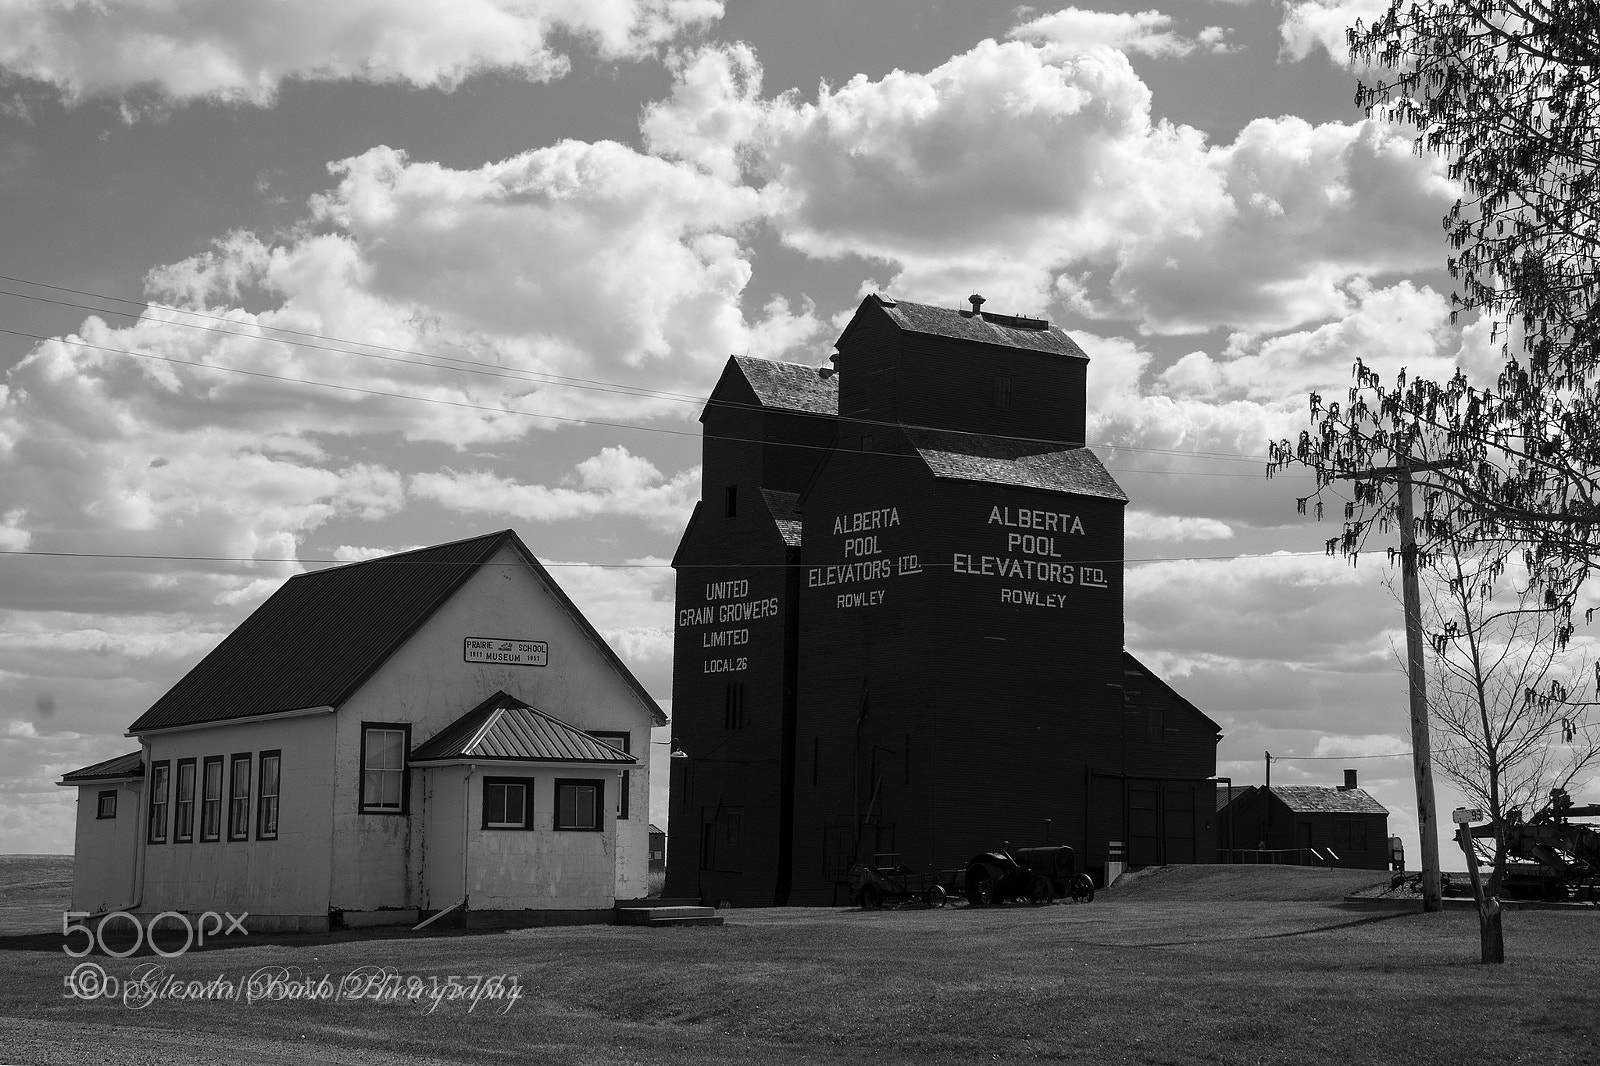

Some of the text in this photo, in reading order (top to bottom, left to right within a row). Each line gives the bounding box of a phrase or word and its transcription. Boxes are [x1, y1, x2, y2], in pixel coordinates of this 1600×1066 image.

[833, 507, 900, 535] ALBERTA
[987, 505, 1085, 535] ALBERTA
[844, 535, 882, 558] POOL
[1008, 532, 1061, 558] POOL
[808, 558, 891, 588] ELEVATORS
[953, 553, 1074, 584] ELEVATORS
[706, 579, 749, 601] UNITED
[836, 589, 885, 609] ROWLEY
[1001, 588, 1067, 609] ROWLEY
[679, 597, 778, 627] GRAIN GROWERS
[466, 640, 546, 653] PRAIRIE SCHOOL
[703, 628, 749, 648] LIMITED
[485, 652, 521, 662] MUSEUM
[703, 657, 748, 674] LOCAL 26
